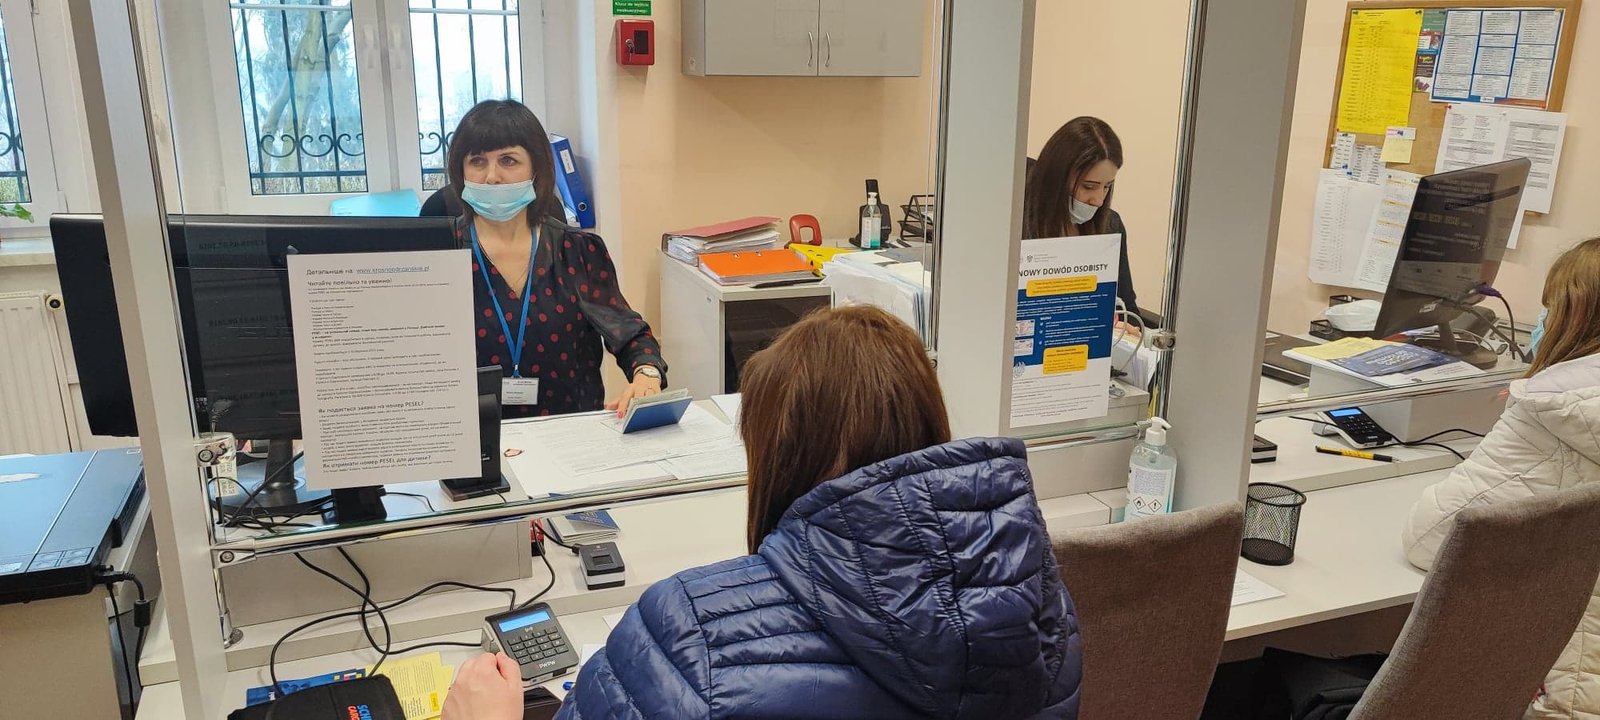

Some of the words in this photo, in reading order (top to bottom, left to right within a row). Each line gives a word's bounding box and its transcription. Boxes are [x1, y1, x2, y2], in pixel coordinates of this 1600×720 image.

[1018, 269, 1041, 277] NOWY
[1043, 265, 1072, 275] DOWÓD
[1073, 263, 1108, 273] OSOBISTY
